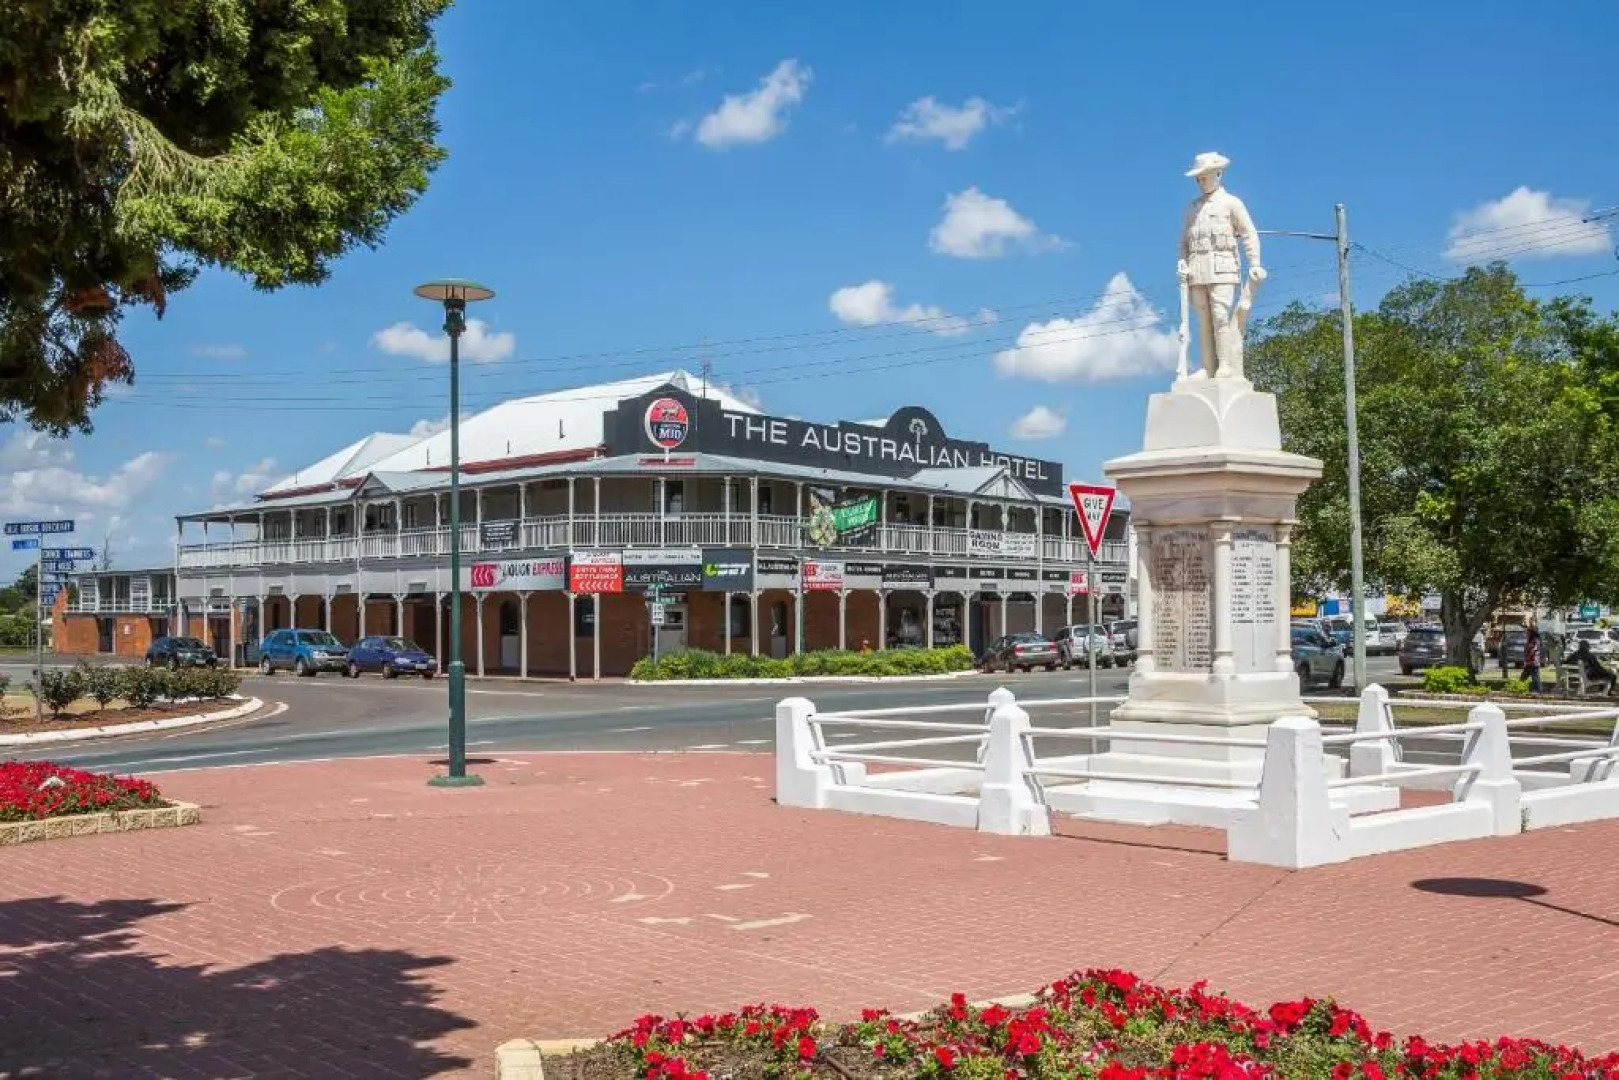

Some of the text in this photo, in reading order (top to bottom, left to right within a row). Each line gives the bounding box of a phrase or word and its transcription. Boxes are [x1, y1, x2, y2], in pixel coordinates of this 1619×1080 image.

[723, 413, 1049, 480] THE AUSTRALIAN HOTEL
[1084, 498, 1105, 510] GIVE
[532, 560, 564, 576] EXPRESS
[625, 573, 701, 582] AUSTRALIAN
